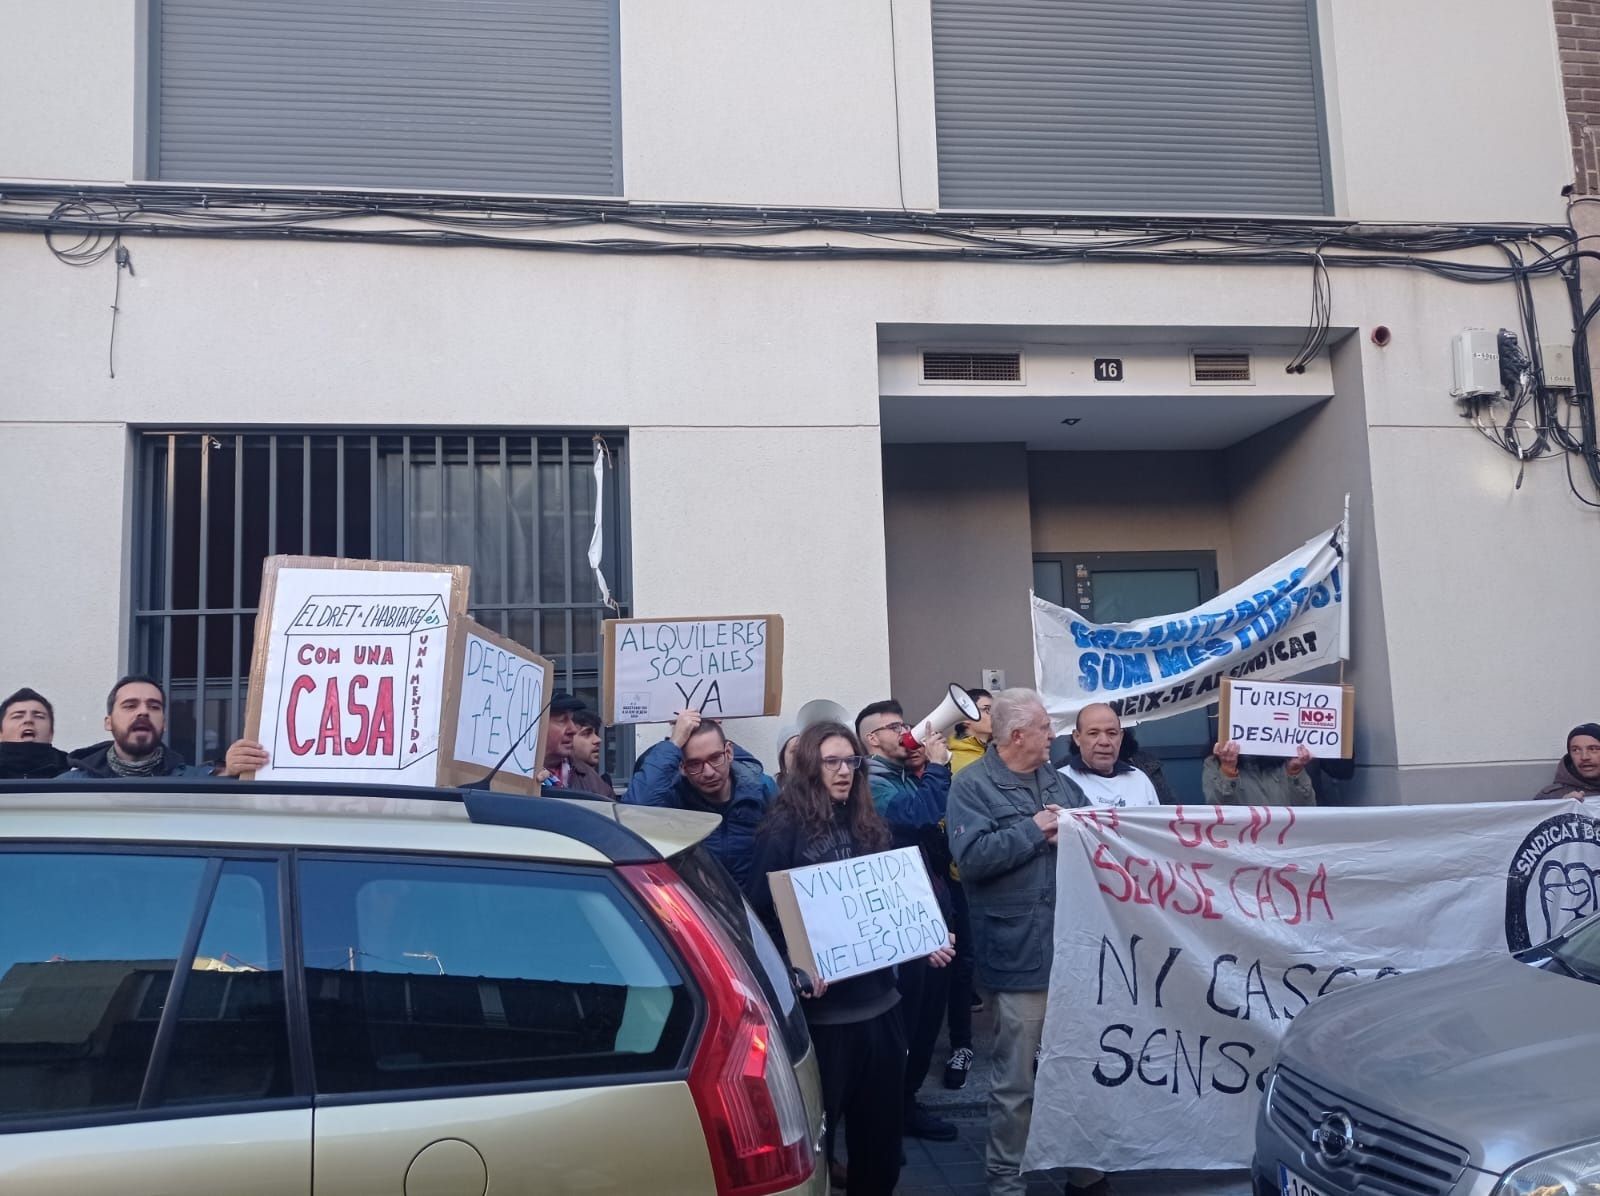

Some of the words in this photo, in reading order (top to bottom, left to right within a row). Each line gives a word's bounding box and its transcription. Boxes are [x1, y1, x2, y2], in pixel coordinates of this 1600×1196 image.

[1100, 362, 1117, 377] 16
[294, 603, 319, 627] EL
[317, 604, 362, 628] DRET
[424, 609, 440, 625] és
[297, 643, 341, 666] COM
[353, 644, 394, 666] UNA
[415, 635, 429, 668] UNA
[620, 621, 768, 659] ALQUILERES
[646, 647, 755, 682] SOCIALES
[1077, 650, 1153, 692] SOM
[286, 674, 395, 756] CASA
[408, 673, 422, 754] MENTIDA
[675, 679, 723, 714] YA
[1233, 686, 1329, 709] TURISMO
[1231, 724, 1340, 746] DESAHUCIO
[1301, 709, 1335, 723] NO+
[1516, 821, 1580, 876] SINDICAT
[793, 850, 918, 899] VIVIENDA
[1093, 843, 1224, 920] SENSE
[1229, 862, 1335, 926] CASA
[841, 881, 909, 920] DIGNA
[857, 916, 884, 938] ES
[889, 900, 930, 927] UNA
[816, 918, 947, 980] NECESIDAD
[1096, 933, 1183, 1008] NI
[1091, 1022, 1271, 1099] SENS
